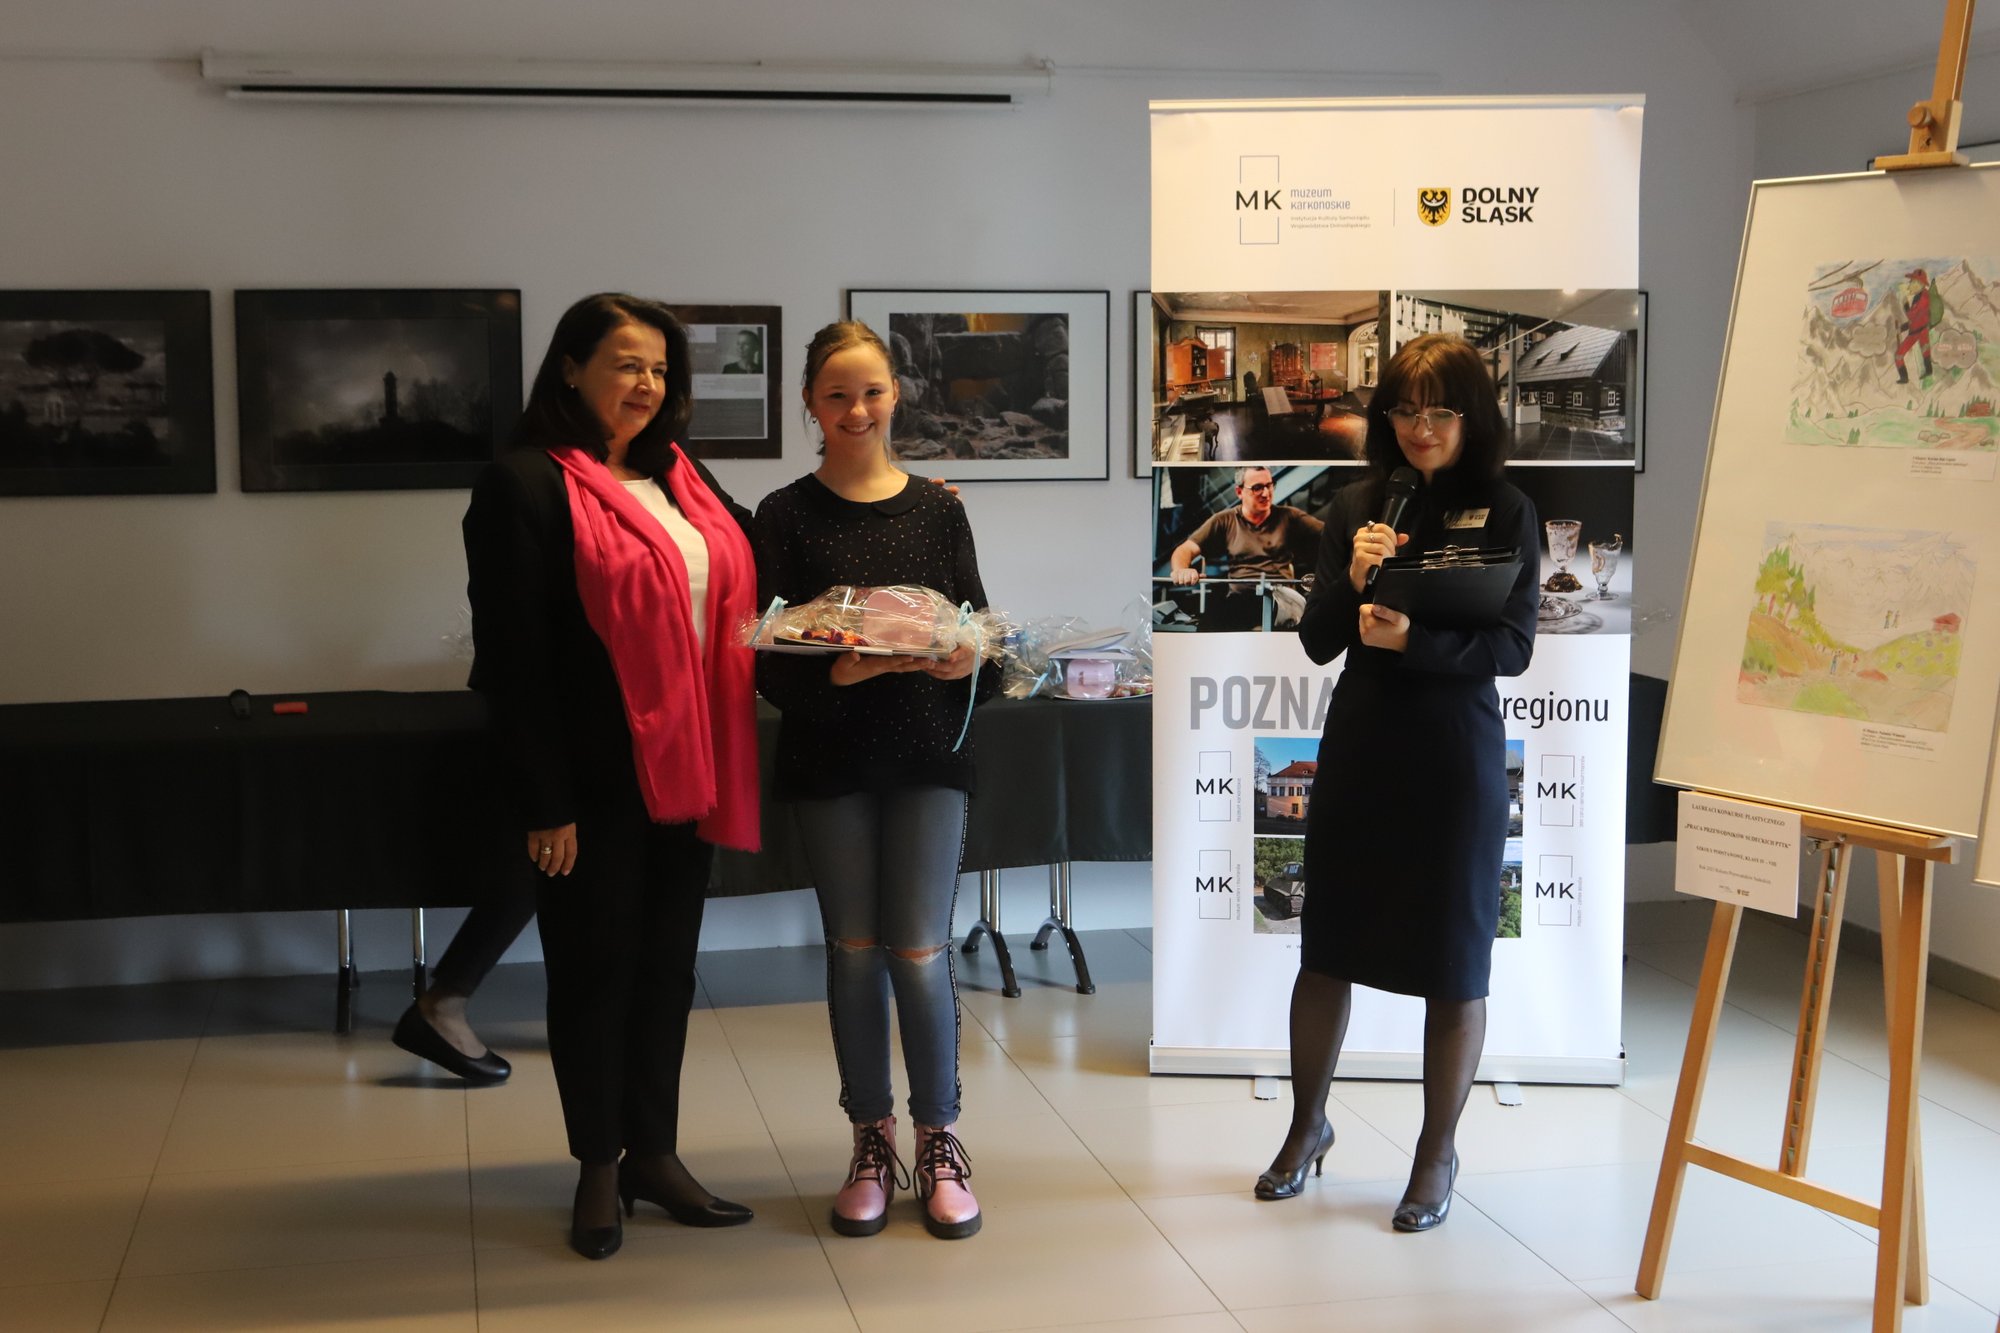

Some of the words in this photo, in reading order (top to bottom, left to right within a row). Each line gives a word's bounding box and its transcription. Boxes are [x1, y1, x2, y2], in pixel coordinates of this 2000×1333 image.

[1236, 189, 1282, 210] MK
[1290, 188, 1332, 198] muzeum
[1462, 187, 1540, 204] DOLNY
[1290, 200, 1351, 210] karkonoskie
[1462, 202, 1534, 226] ŚLĄSK
[1502, 691, 1609, 729] regionu
[1195, 778, 1234, 795] MK
[1537, 782, 1577, 800] MK
[1195, 876, 1234, 893] MK
[1535, 882, 1575, 899] MK
